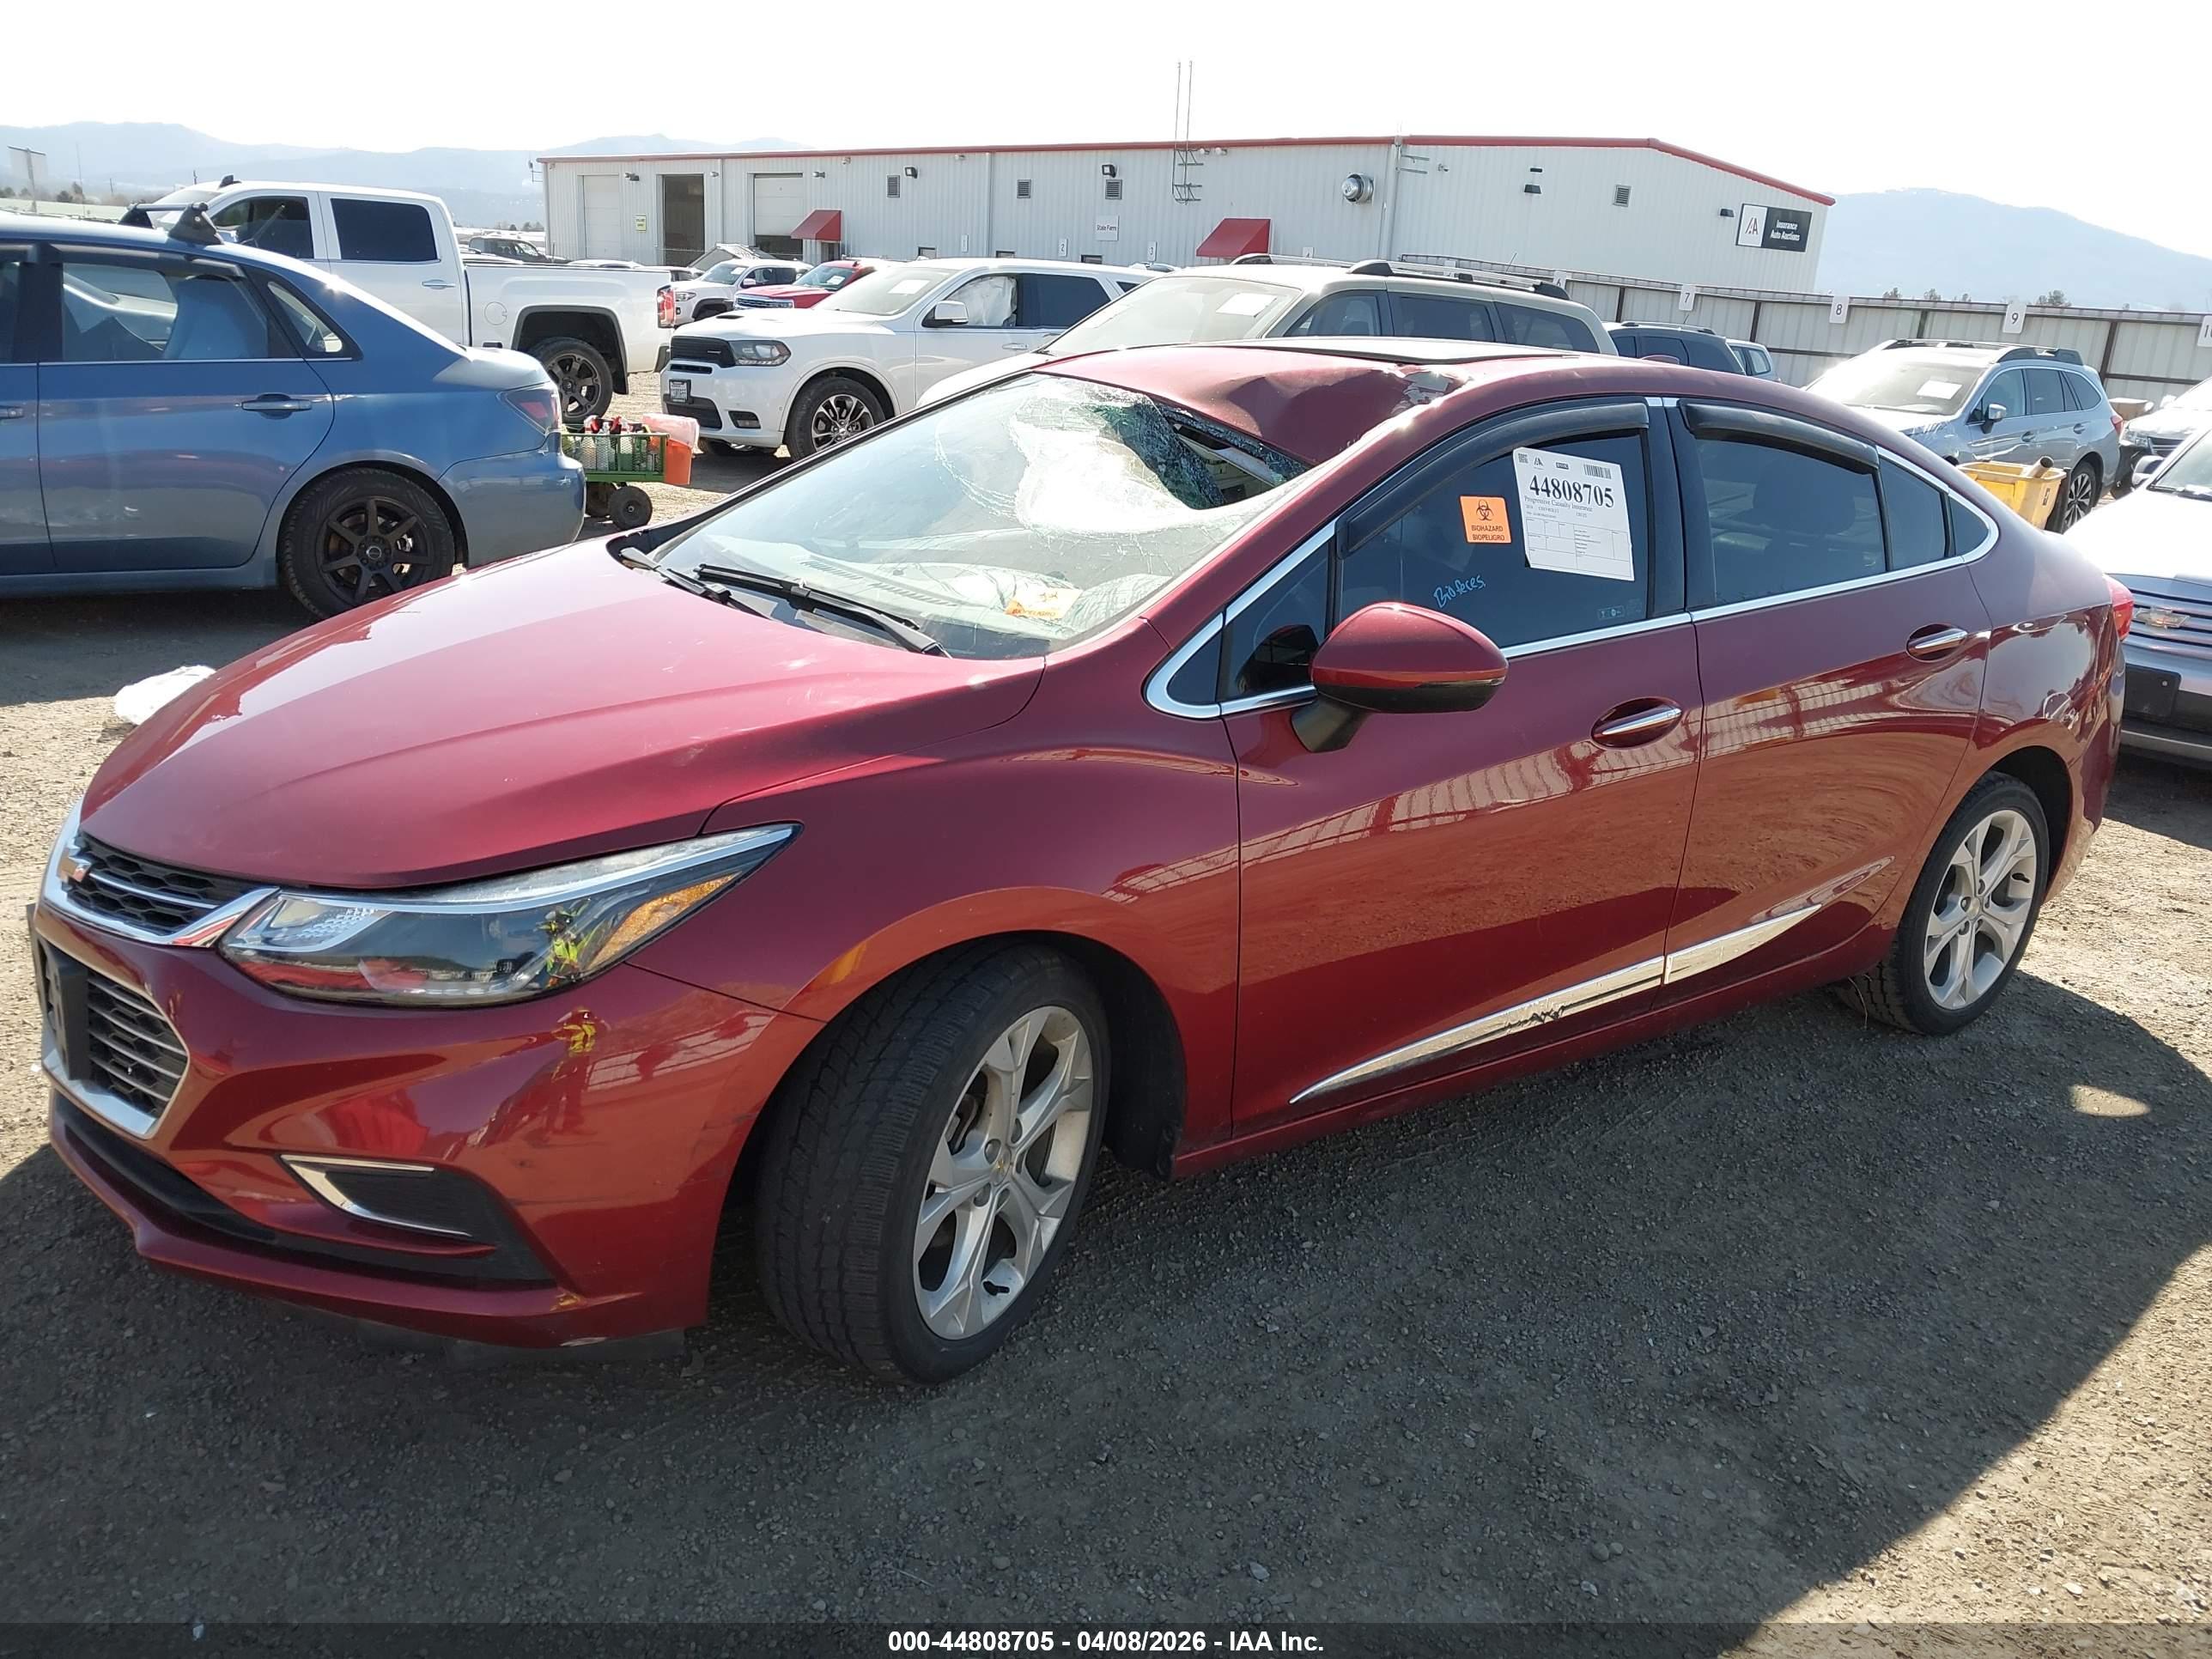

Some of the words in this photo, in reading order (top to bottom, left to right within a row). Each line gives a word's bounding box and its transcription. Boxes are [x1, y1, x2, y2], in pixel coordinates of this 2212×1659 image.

[1776, 219, 1798, 230] Insurance
[1770, 229, 1781, 240] Auto
[1781, 230, 1801, 241] Auctions
[1684, 292, 1691, 303] 7
[1836, 303, 1843, 316] 8
[2011, 312, 2019, 325] 9
[2203, 324, 2212, 338] 1
[1529, 474, 1614, 508] 44808705
[1524, 495, 1551, 506] Progressive
[1551, 500, 1571, 509] Casualty
[1571, 503, 1594, 513] Insurance
